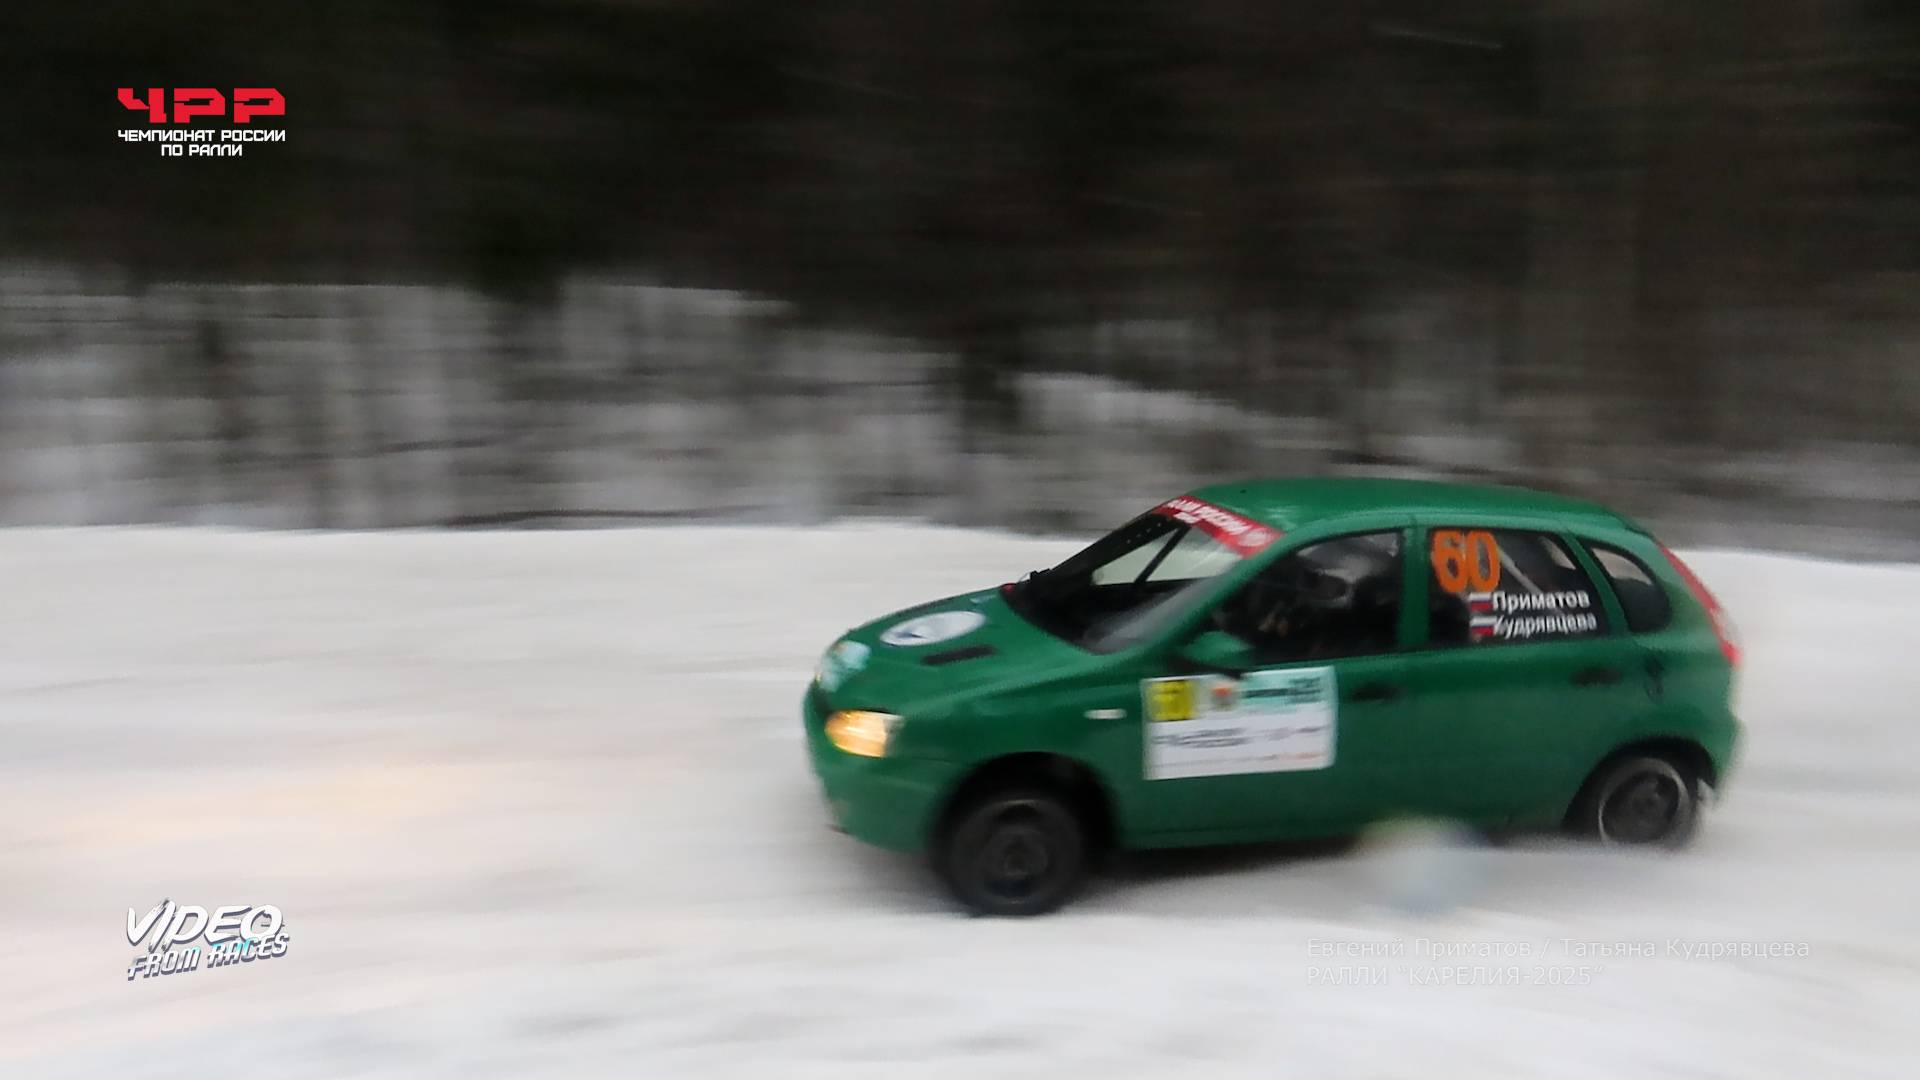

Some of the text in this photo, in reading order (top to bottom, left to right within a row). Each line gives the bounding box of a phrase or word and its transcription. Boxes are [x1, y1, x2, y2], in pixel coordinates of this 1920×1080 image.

[1430, 530, 1501, 593] 60
[1492, 590, 1590, 615] Приматов
[1493, 612, 1597, 639] Кудрявцева
